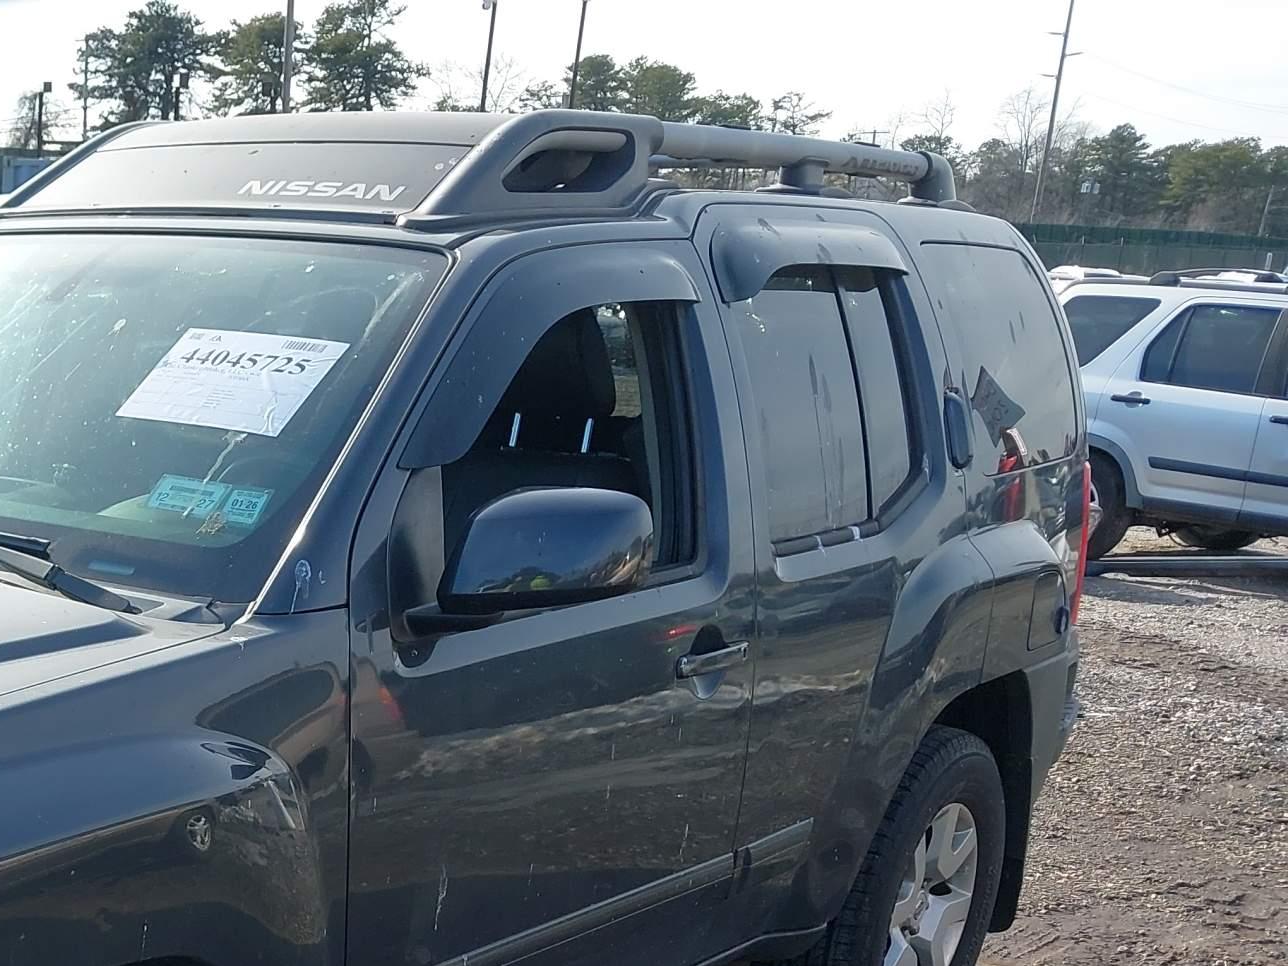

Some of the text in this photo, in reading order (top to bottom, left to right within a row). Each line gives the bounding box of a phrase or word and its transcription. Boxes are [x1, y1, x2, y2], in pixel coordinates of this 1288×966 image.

[237, 179, 407, 201] NISSAN
[180, 347, 313, 376] 44045725
[155, 491, 169, 502] 12
[197, 498, 215, 509] 27
